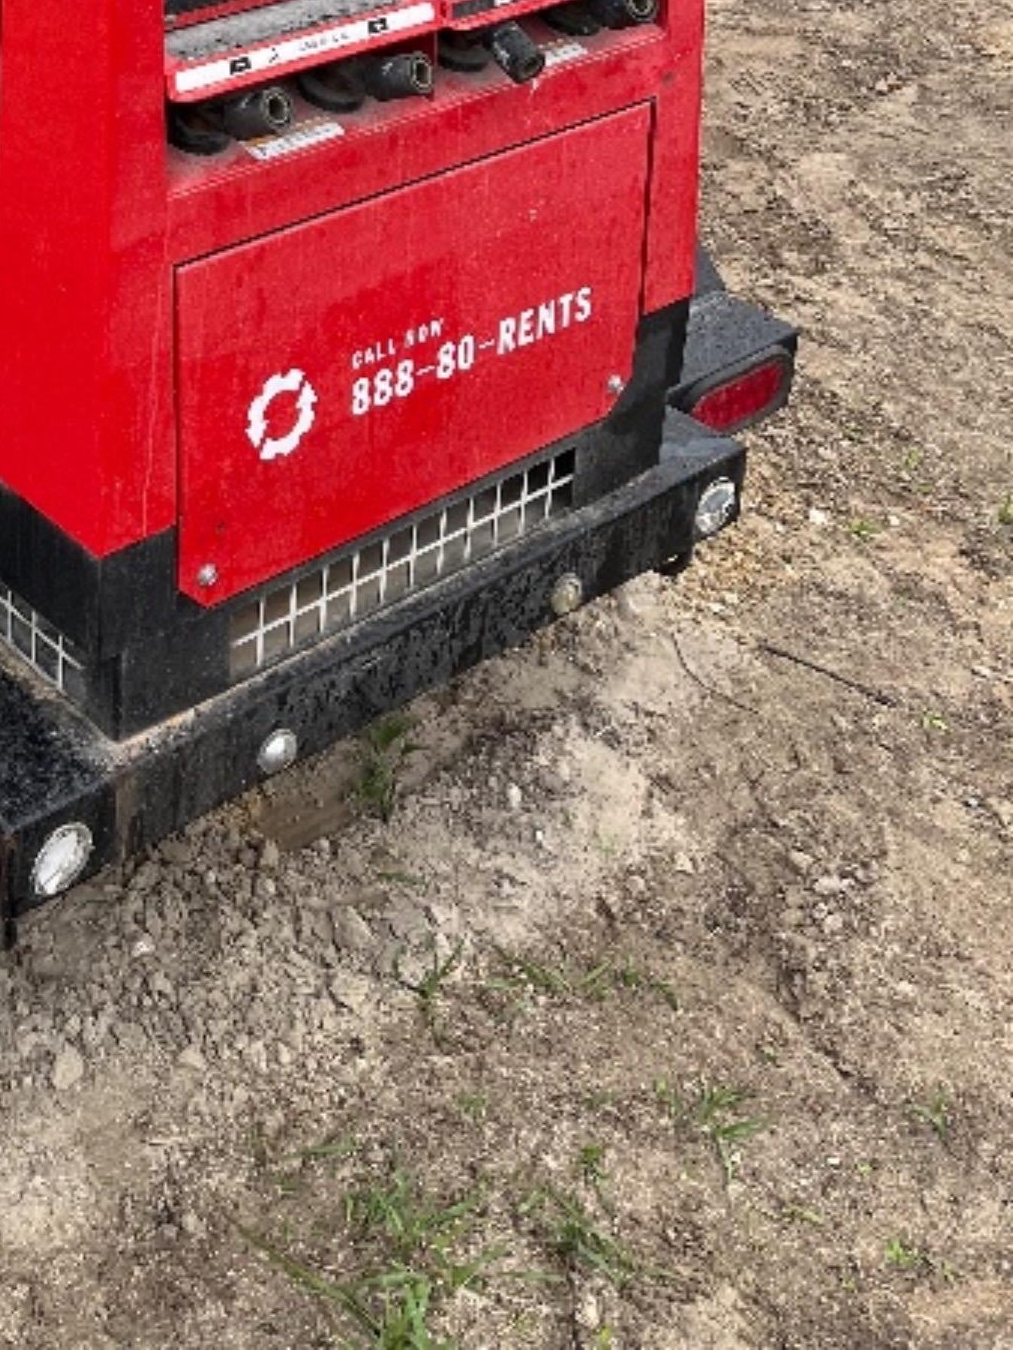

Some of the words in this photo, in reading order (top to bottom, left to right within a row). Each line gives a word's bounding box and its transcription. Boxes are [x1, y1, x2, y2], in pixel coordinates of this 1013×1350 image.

[351, 286, 593, 415] 888-80-RENTS
[352, 338, 397, 370] CALL
[403, 317, 445, 349] NOW
